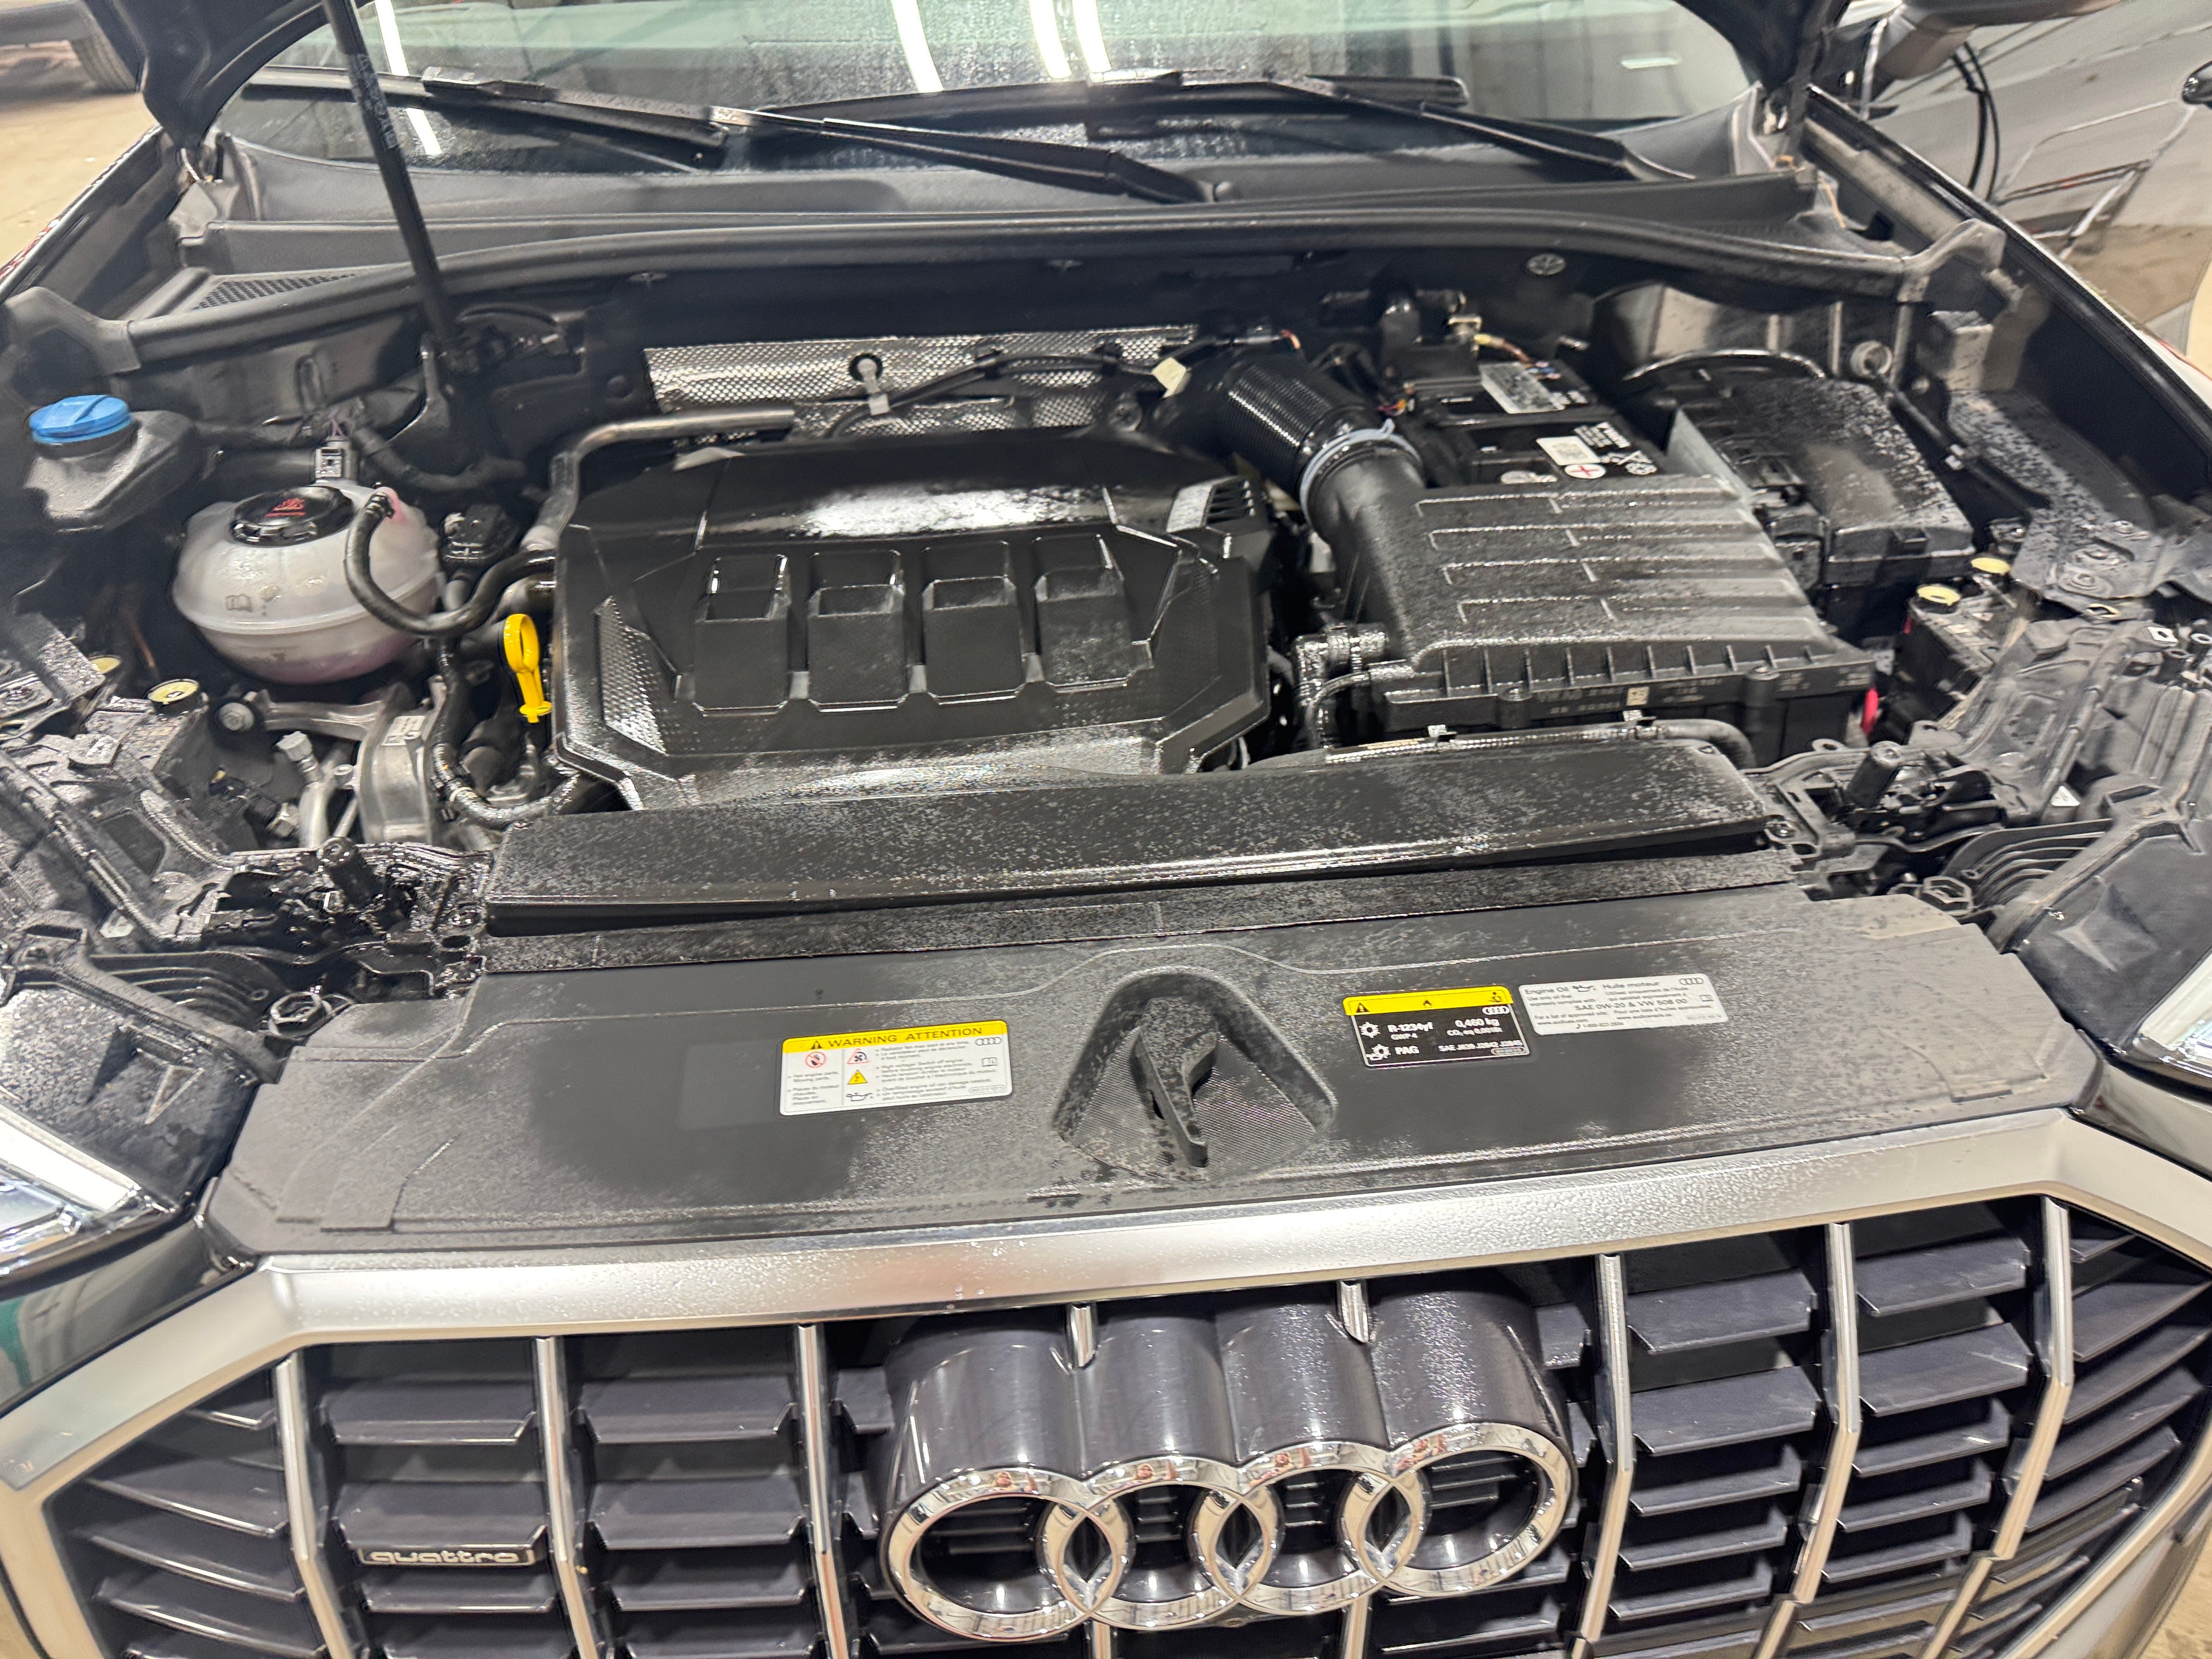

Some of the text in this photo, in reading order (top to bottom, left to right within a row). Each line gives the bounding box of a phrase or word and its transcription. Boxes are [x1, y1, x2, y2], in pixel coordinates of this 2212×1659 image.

[1485, 1017, 1500, 1026] kg
[1387, 1022, 1434, 1032] R-1234yf
[828, 1035, 897, 1047] WARNING
[906, 1027, 982, 1041] ATTENTION
[1394, 1045, 1420, 1055] PAG
[370, 1550, 519, 1565] quattro
